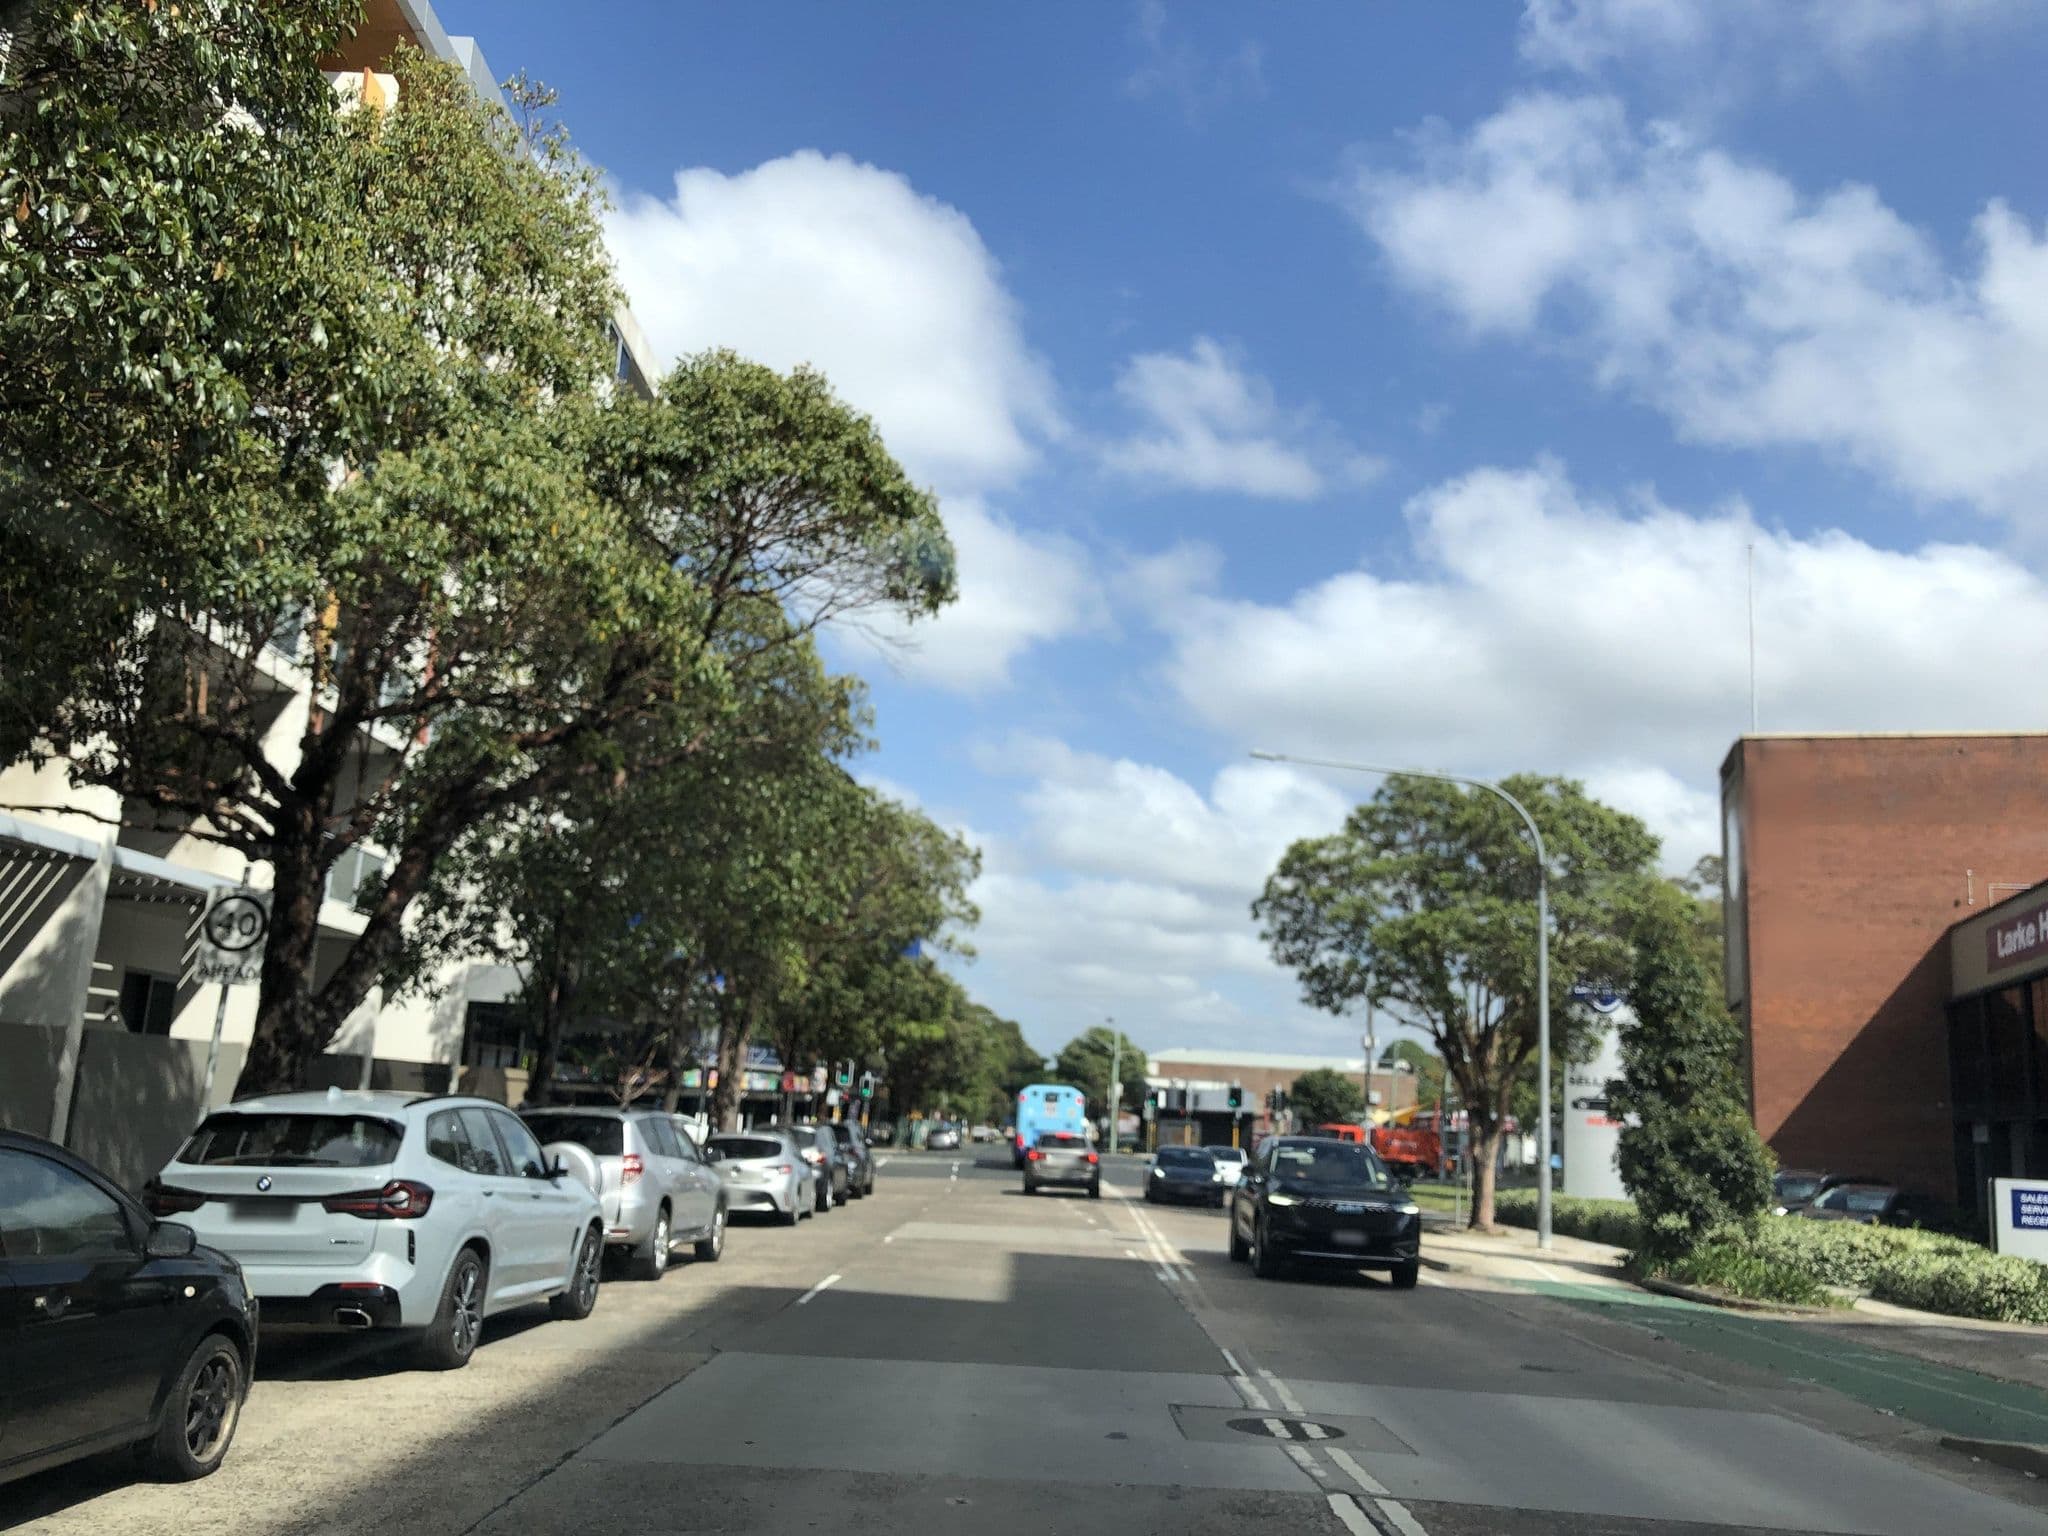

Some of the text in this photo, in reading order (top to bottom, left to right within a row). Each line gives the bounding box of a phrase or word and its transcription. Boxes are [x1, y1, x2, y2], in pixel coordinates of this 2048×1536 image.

[217, 911, 256, 938] 40
[1997, 921, 2035, 958] Larke
[200, 963, 256, 980] AHEAD
